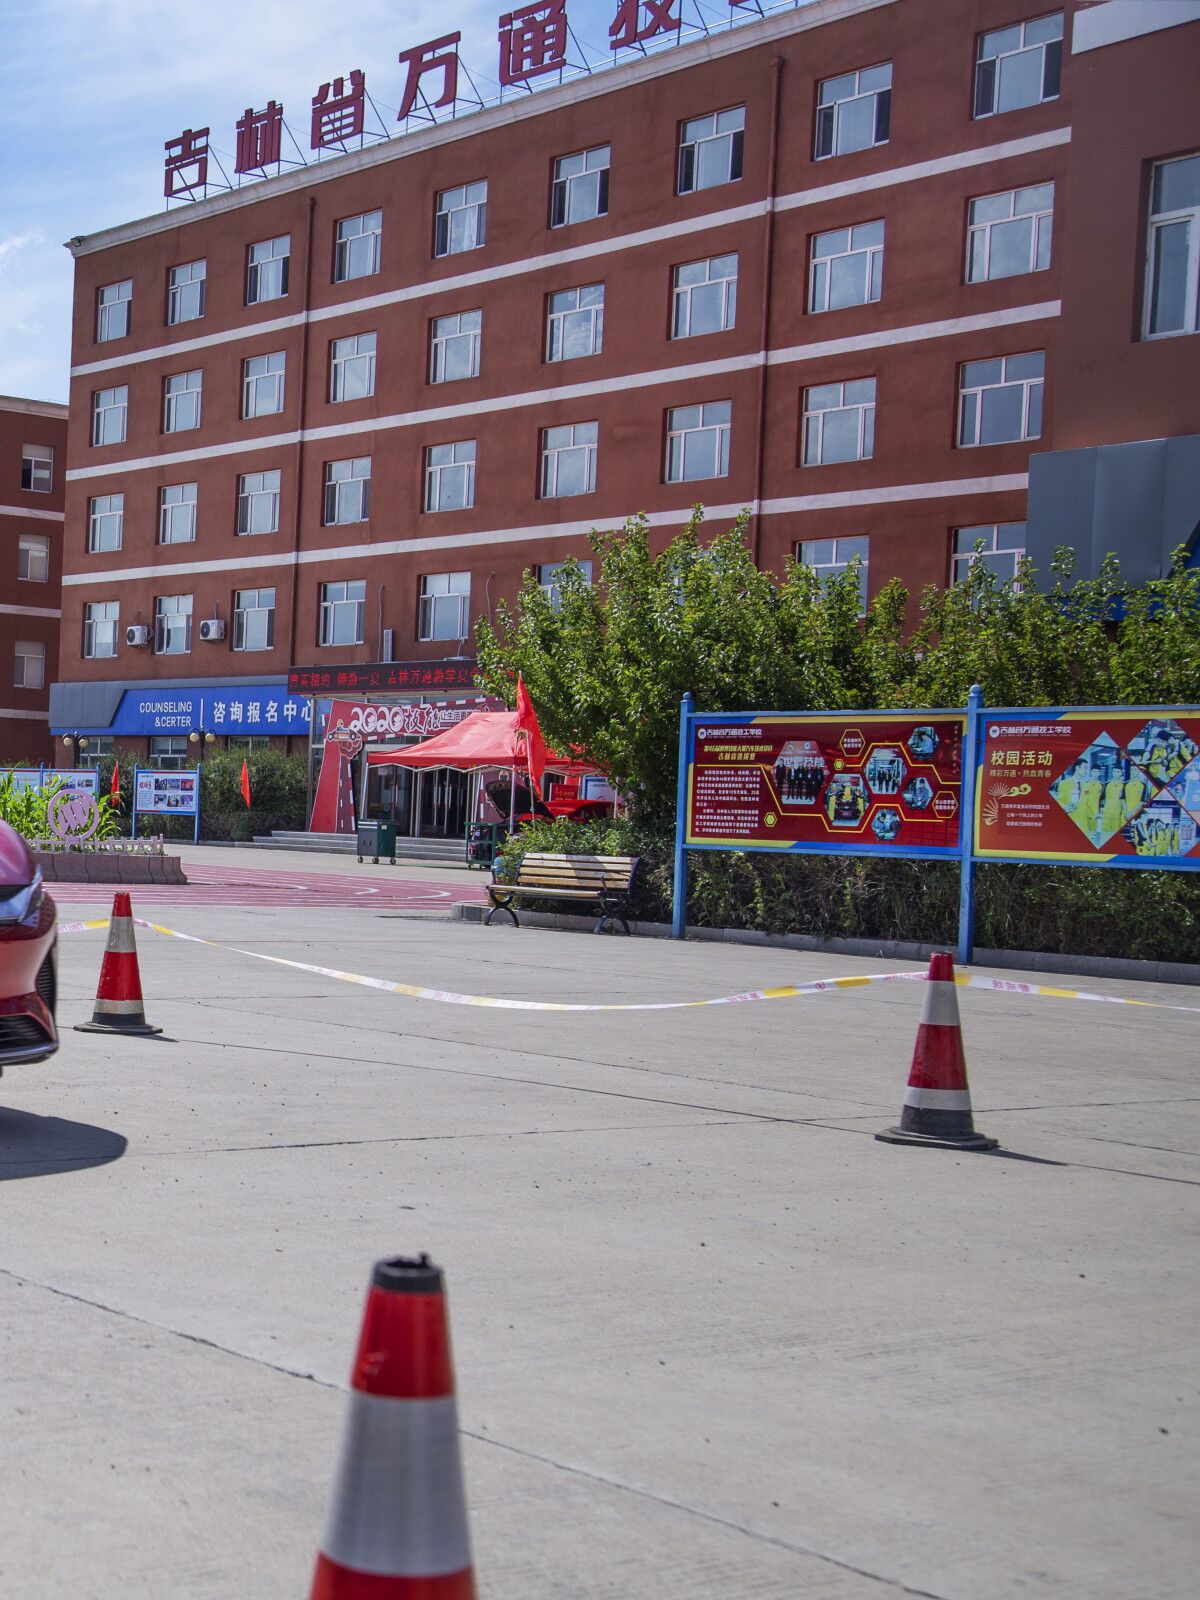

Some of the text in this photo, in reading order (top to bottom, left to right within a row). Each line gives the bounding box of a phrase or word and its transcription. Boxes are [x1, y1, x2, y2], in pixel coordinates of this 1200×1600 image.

[165, 0, 763, 198] 吉林省万通技
[139, 701, 193, 713] COUNSELING
[213, 700, 314, 723] 咨询报名中心
[154, 715, 192, 727] &CERTER
[991, 751, 1053, 766] 校园活动
